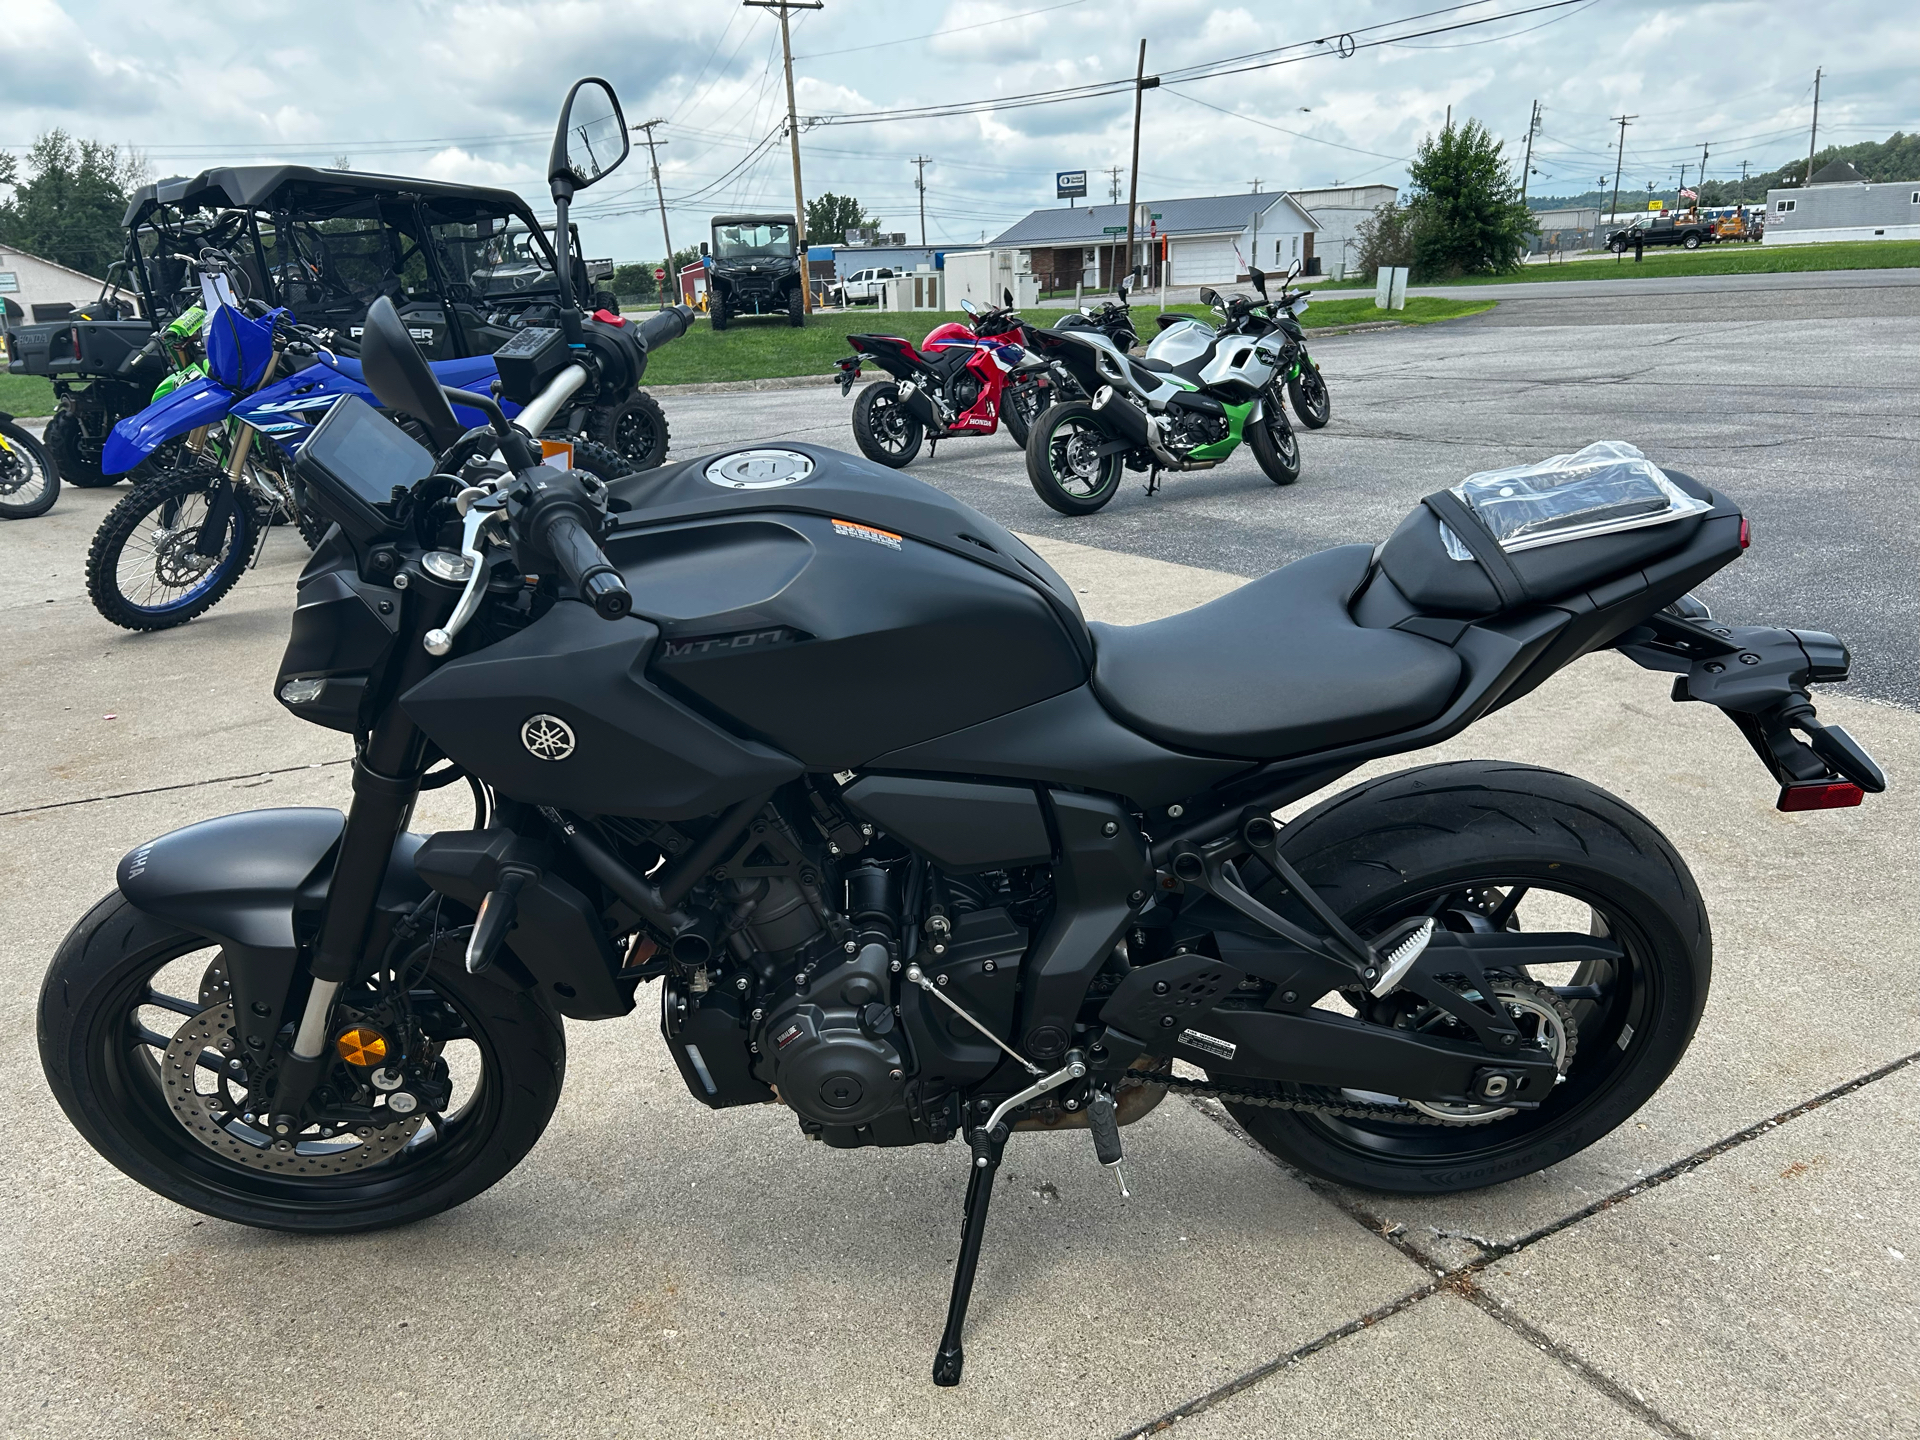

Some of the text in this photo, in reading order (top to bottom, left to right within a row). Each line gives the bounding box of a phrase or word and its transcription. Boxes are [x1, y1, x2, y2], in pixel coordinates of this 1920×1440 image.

[19, 333, 48, 345] HONDA
[969, 418, 992, 427] HONDA
[664, 629, 784, 658] MT-07
